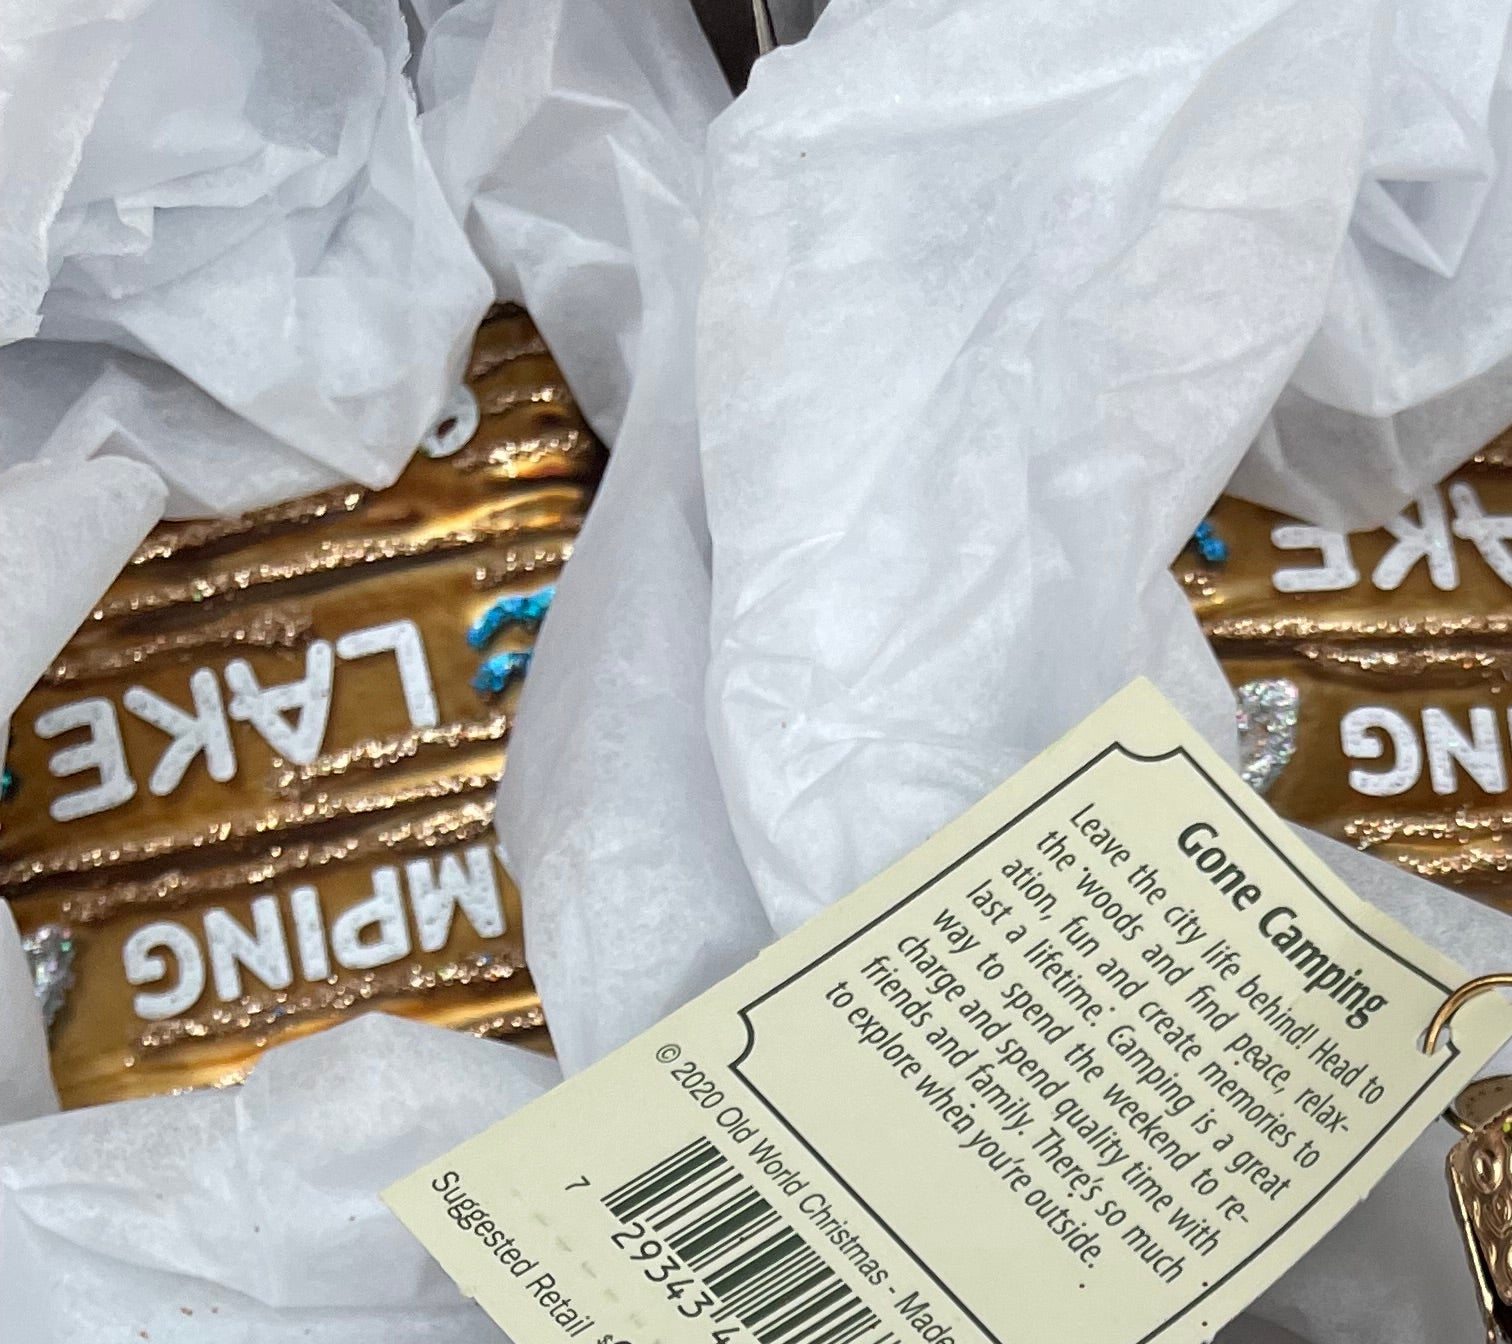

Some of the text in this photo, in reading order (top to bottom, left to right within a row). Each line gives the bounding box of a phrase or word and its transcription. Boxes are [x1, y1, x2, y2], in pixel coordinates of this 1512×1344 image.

[34, 619, 441, 822] LAKE
[931, 906, 1249, 1224] way to spend the weekend to re-
[964, 877, 1292, 1202] last a lifetime. Camping is a great
[999, 857, 1321, 1169] ation, fun and create memories to
[1035, 829, 1349, 1134] the woods and find peace, relax-
[1068, 801, 1385, 1105] Leave the city life behind! Head to
[1176, 820, 1389, 1030] Gone Camping
[563, 1174, 591, 1191] 7
[609, 1220, 715, 1319] 29343
[668, 1060, 725, 1109] 2020
[714, 1105, 760, 1145] Old
[746, 1136, 811, 1197] World
[797, 1192, 889, 1286] Christmas
[823, 979, 1102, 1269] to explore when you're outside.
[859, 954, 1186, 1285] friends and family. There's so much
[896, 934, 1222, 1257] charge and spend quality time with
[430, 1169, 540, 1278] Suggested
[523, 1271, 596, 1338] Retail
